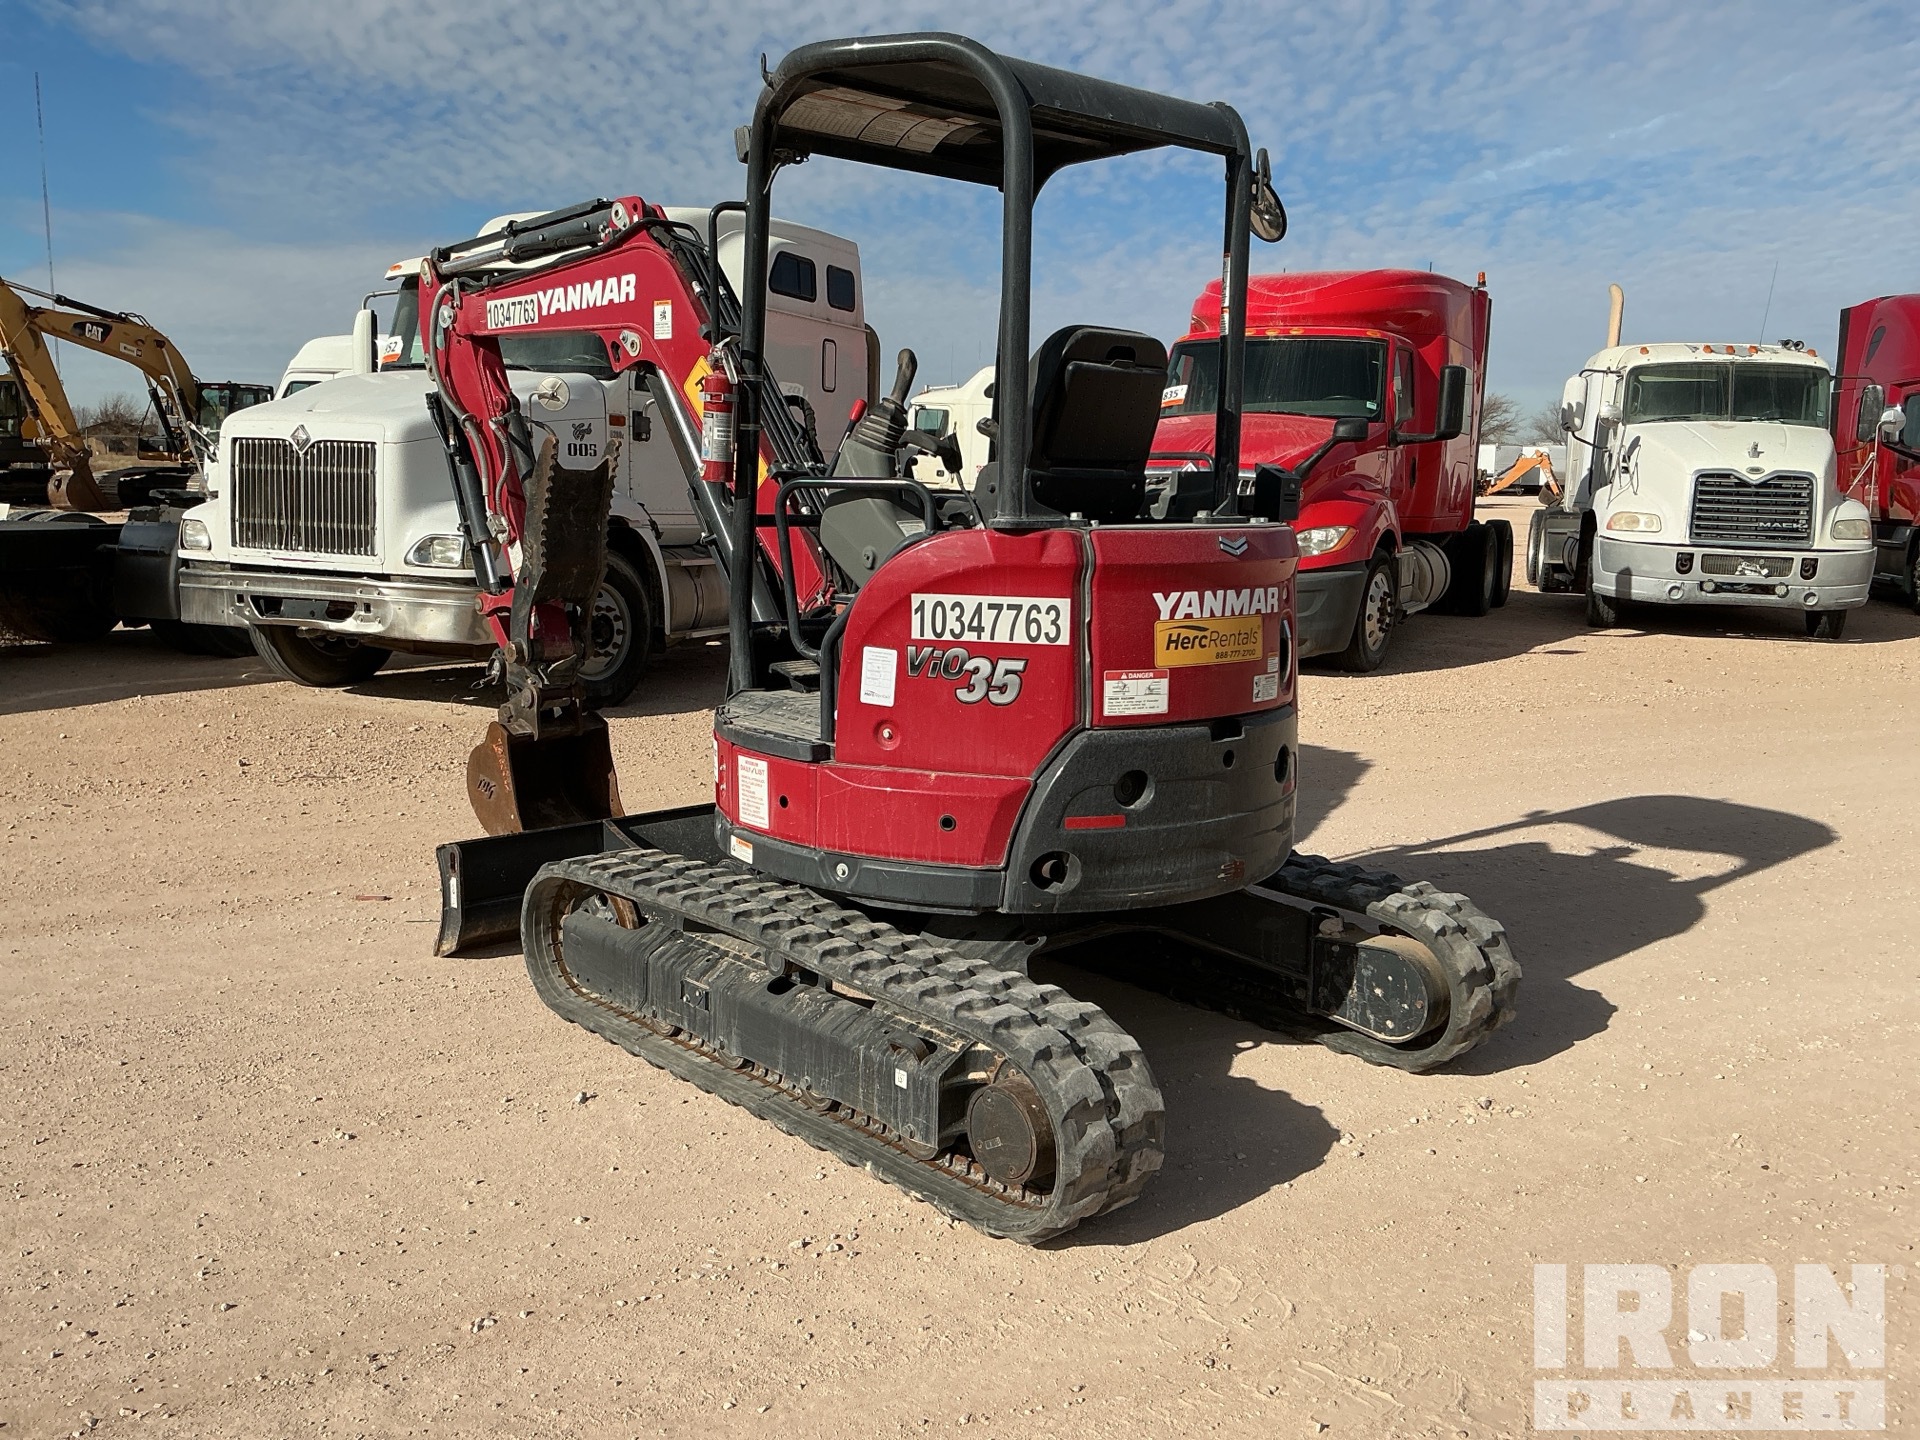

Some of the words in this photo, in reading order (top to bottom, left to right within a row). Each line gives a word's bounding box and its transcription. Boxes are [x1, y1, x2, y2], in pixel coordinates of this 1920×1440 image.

[487, 298, 536, 329] 10347763
[536, 273, 637, 316] YANMAR
[85, 323, 103, 341] CAT
[1162, 389, 1179, 401] 835
[567, 442, 597, 457] 005
[1759, 522, 1806, 530] MACK
[1152, 587, 1279, 620] YANMAR
[914, 599, 1062, 644] 10347763
[1165, 627, 1259, 651] HercRentals
[1215, 648, 1256, 660] 888-777-2700
[955, 656, 1029, 706] 35
